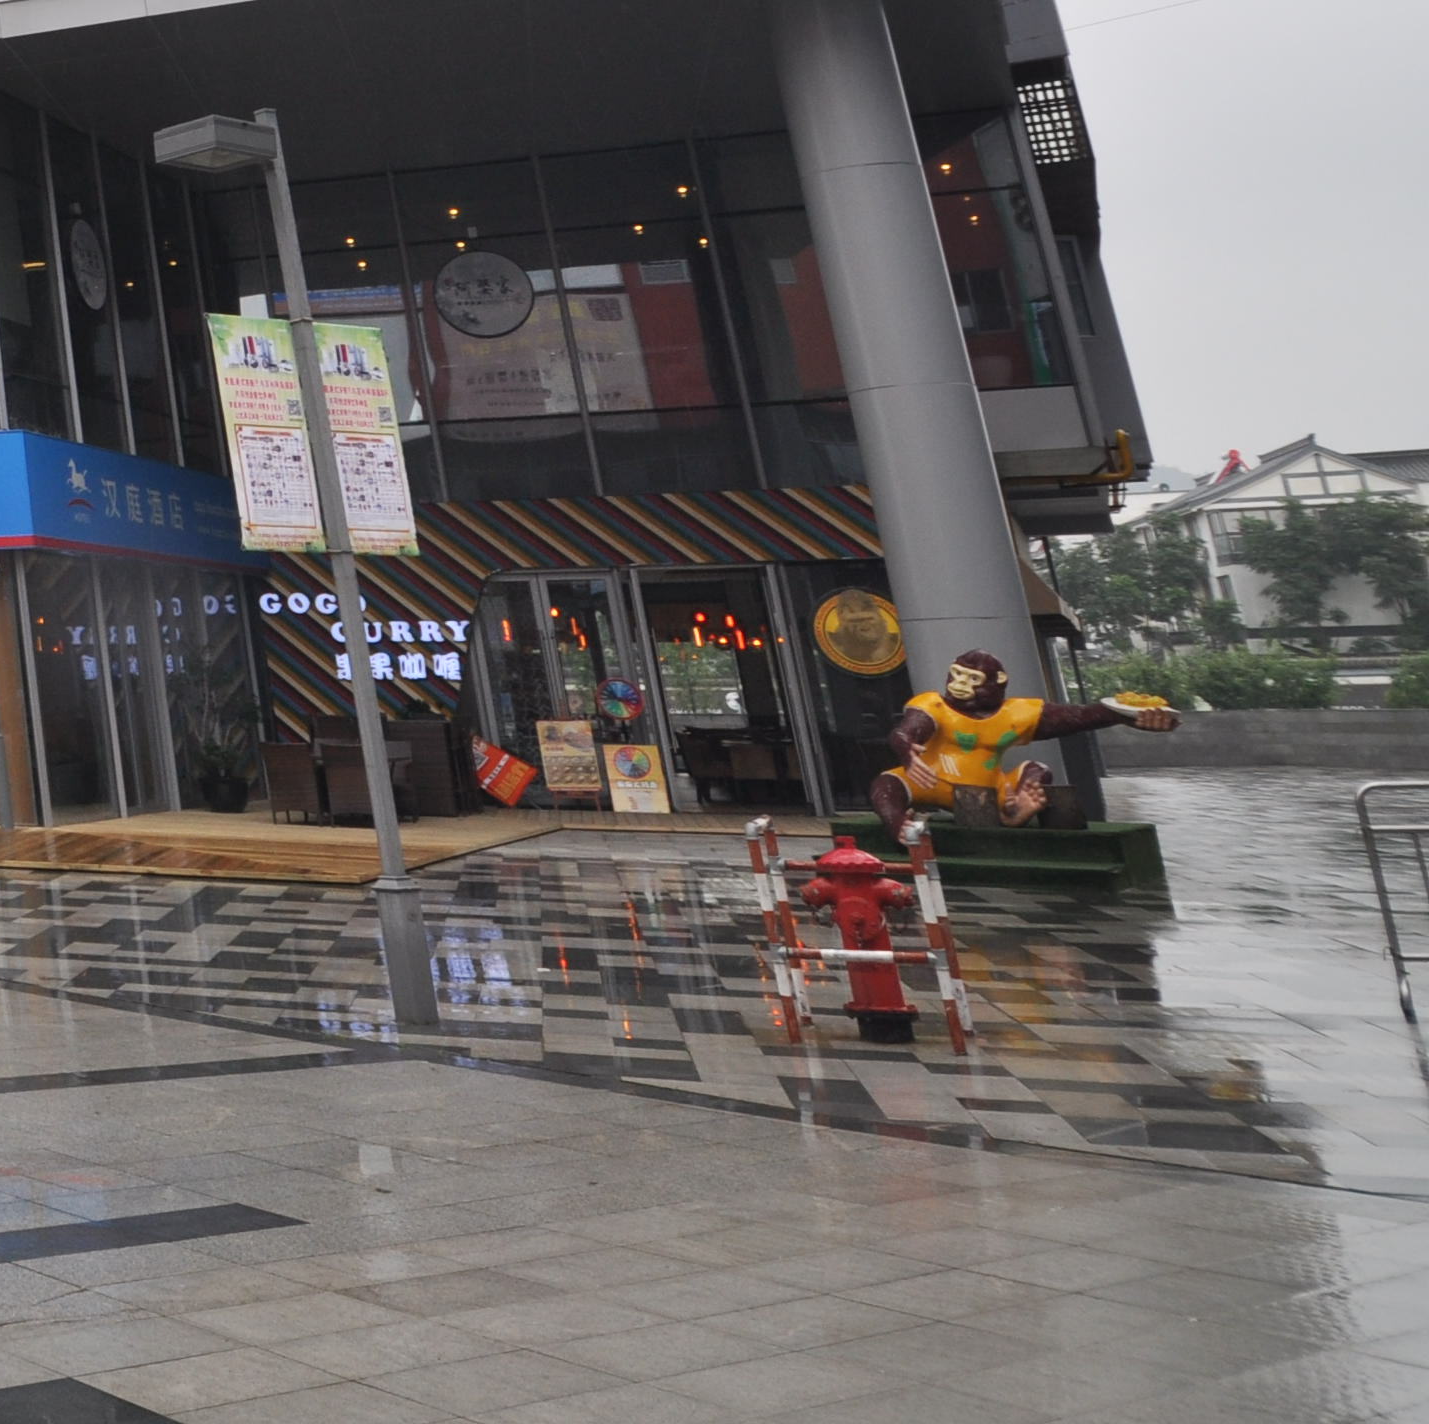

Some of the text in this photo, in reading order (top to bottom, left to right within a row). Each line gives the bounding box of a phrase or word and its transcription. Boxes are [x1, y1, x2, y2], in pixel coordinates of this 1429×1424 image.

[101, 477, 185, 531] 汉庭酒店
[259, 592, 367, 614] GOG
[330, 620, 470, 643] CURRY
